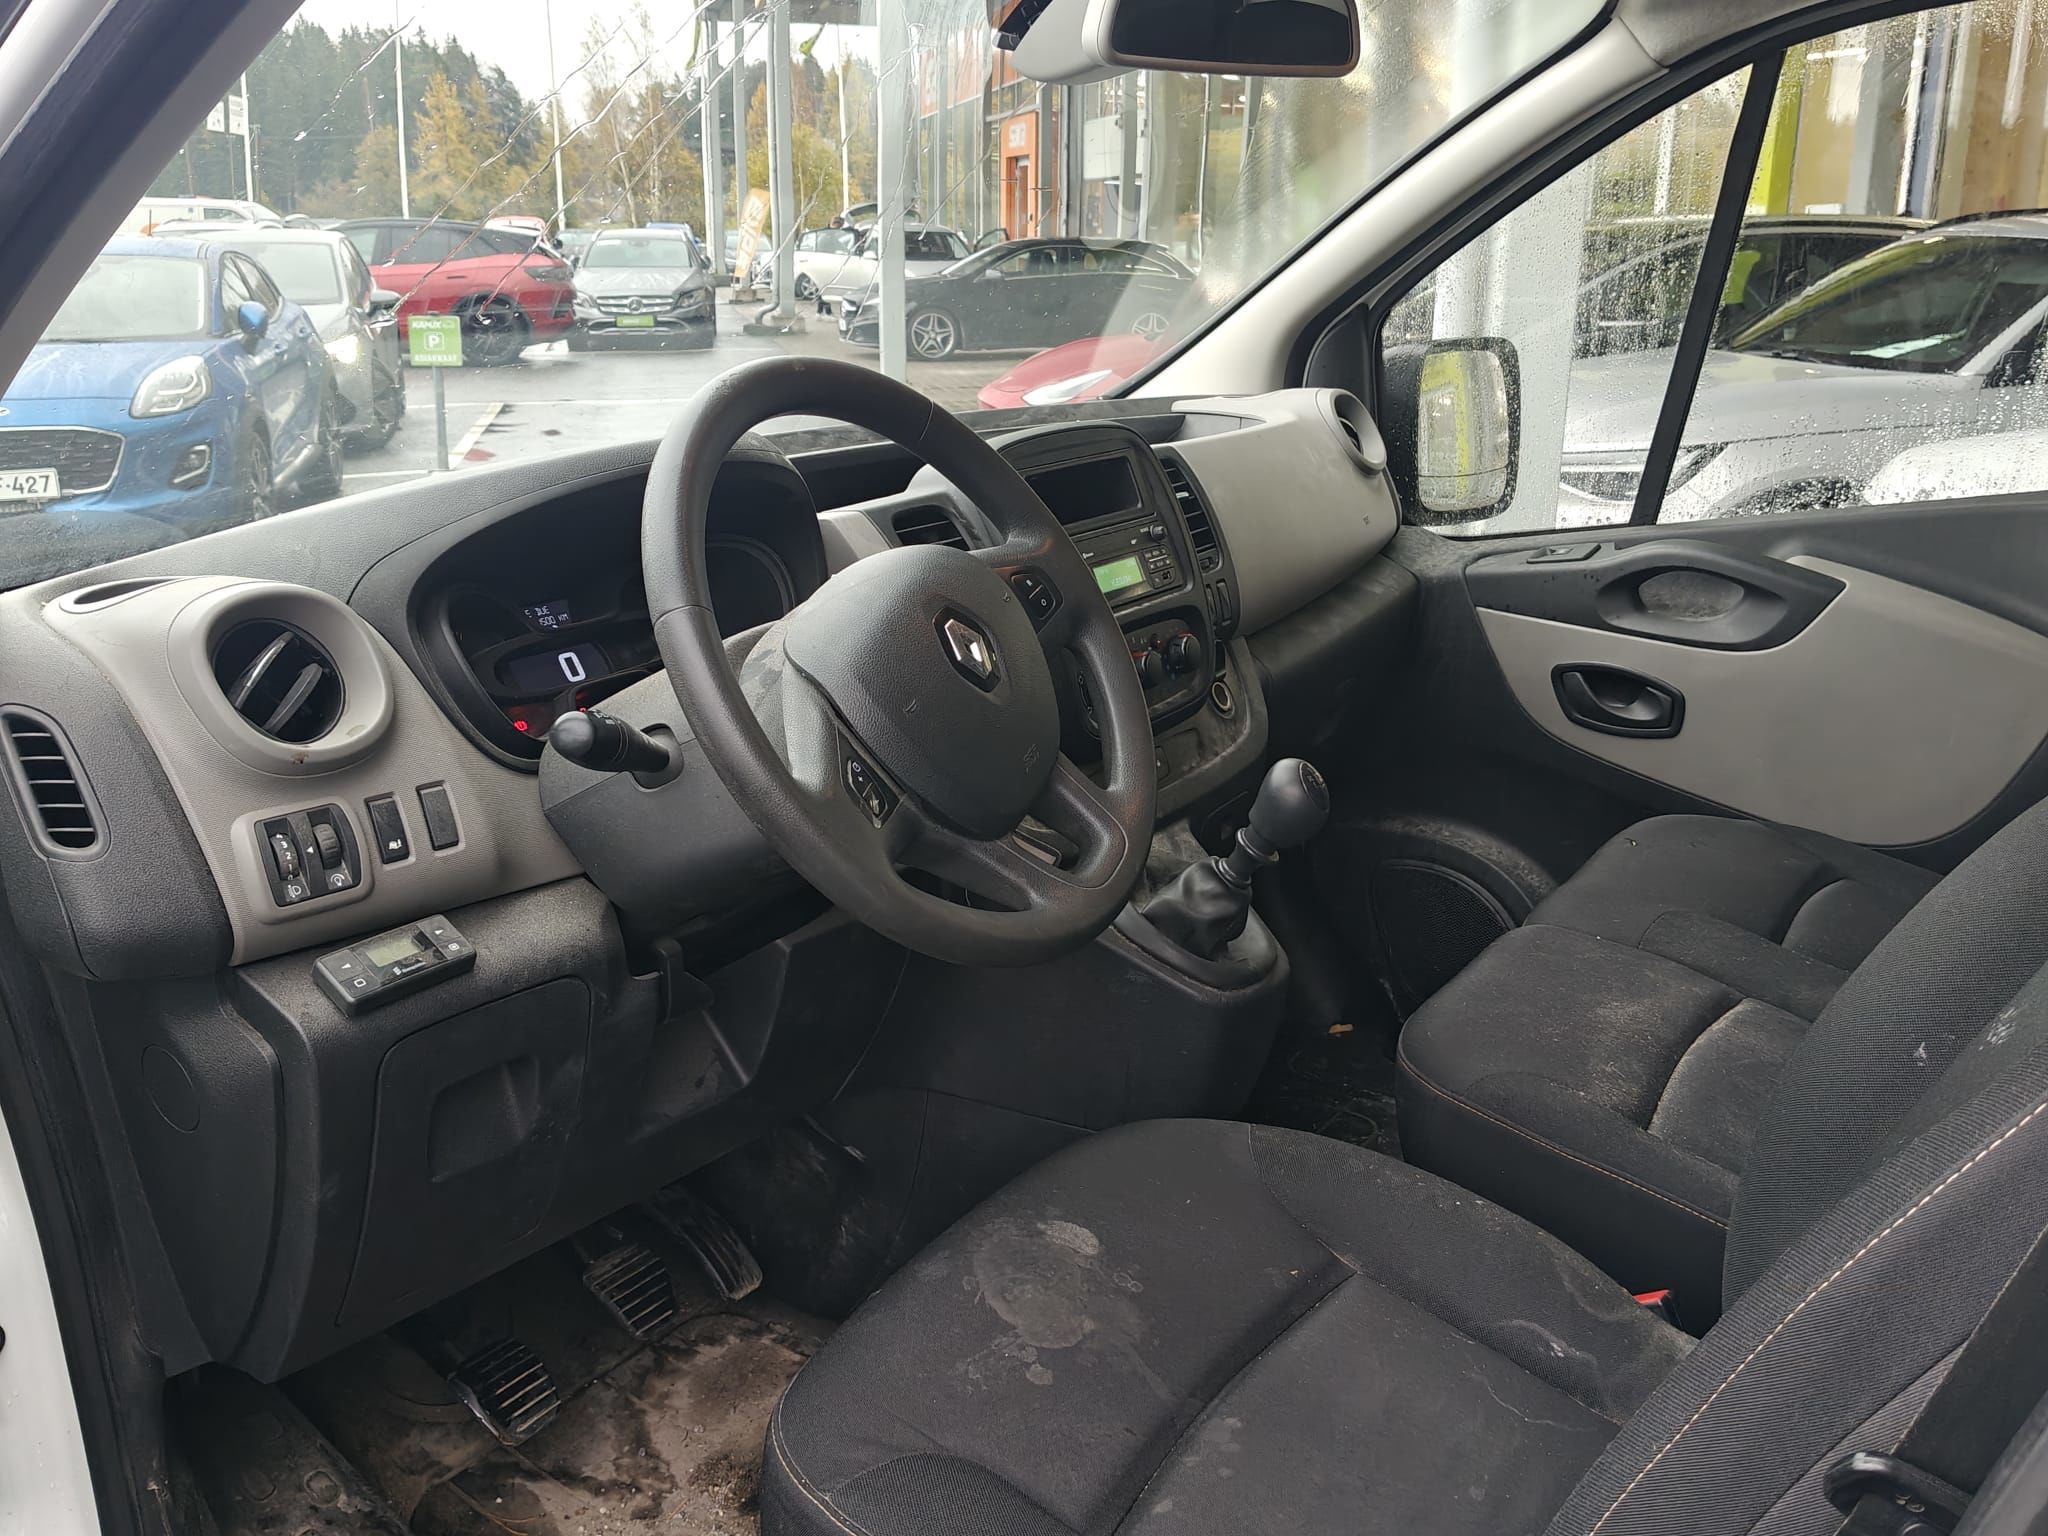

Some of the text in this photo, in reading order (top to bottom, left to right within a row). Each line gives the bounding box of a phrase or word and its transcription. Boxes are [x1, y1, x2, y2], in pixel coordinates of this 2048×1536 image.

[428, 335, 440, 349] P
[0, 475, 49, 495] -427
[558, 651, 586, 683] 0
